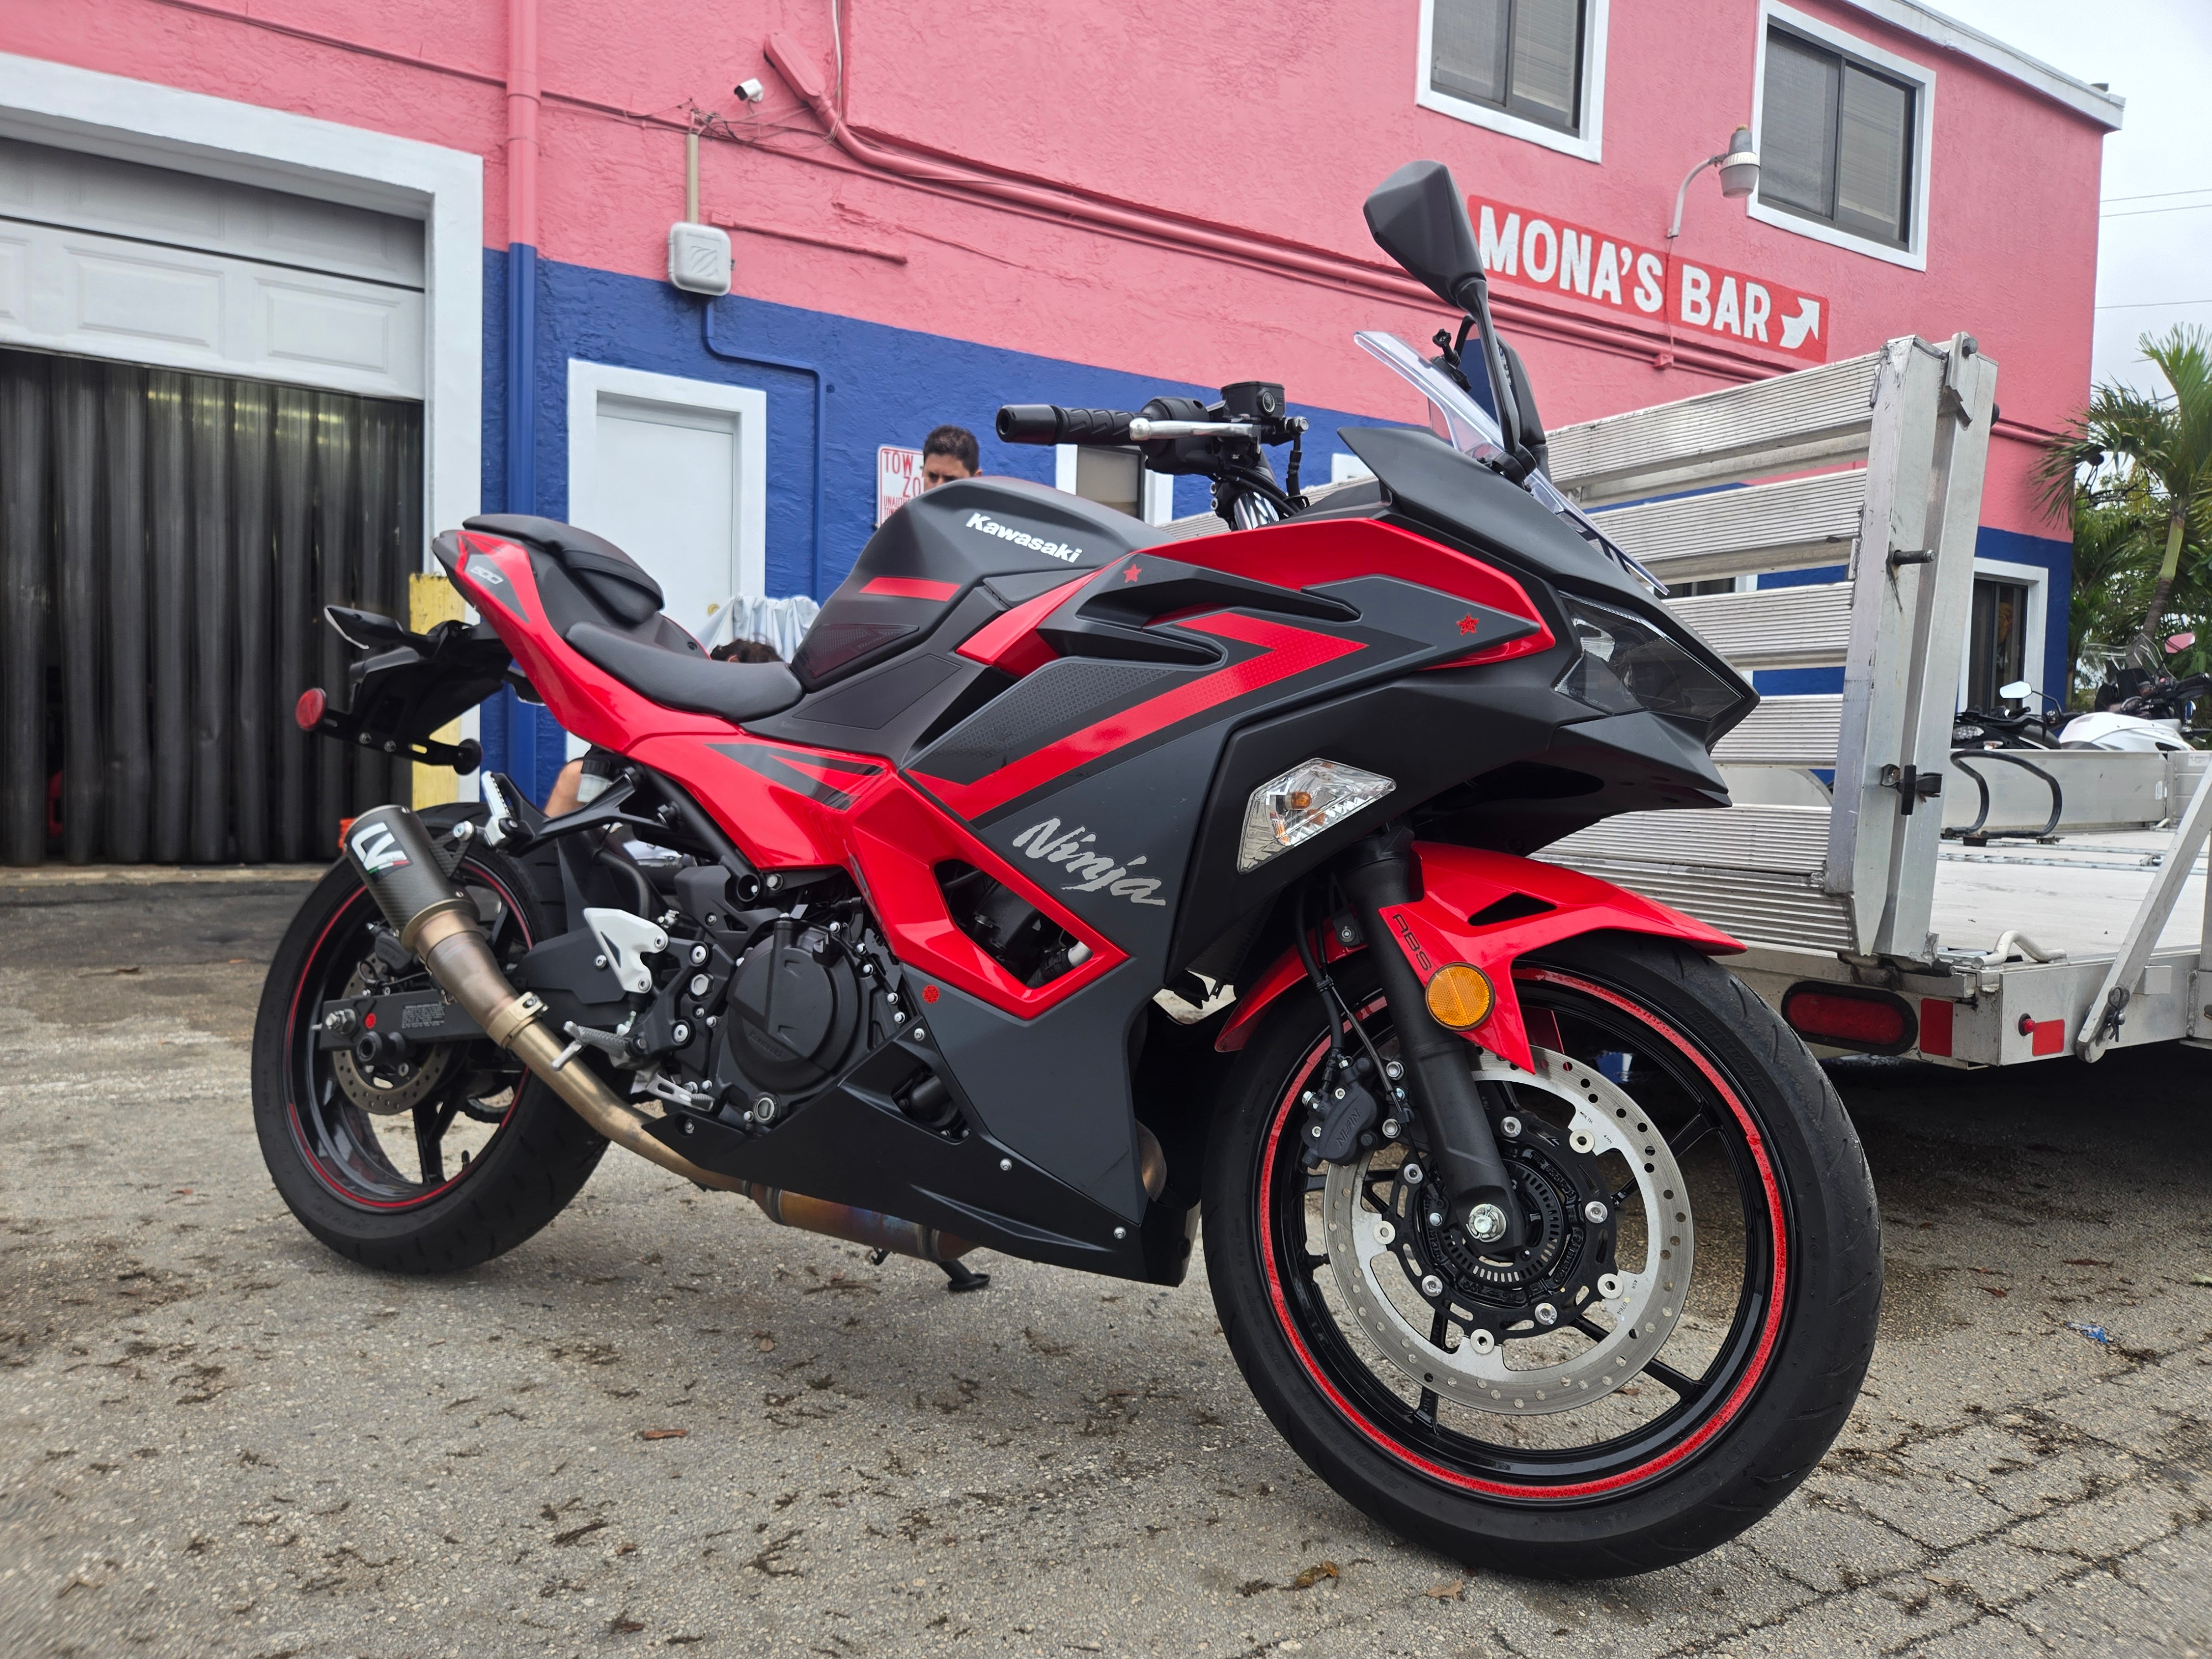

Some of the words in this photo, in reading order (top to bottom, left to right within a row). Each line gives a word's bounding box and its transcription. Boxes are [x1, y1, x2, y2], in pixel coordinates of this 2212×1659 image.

[1479, 205, 1663, 312] MONA'S
[1681, 264, 1771, 342] BAR
[884, 451, 914, 476] TOW
[902, 476, 921, 498] ZO
[966, 512, 1083, 564] Kawasaki
[470, 566, 504, 585] 500
[1012, 817, 1166, 906] Ninja
[1391, 914, 1432, 971] ABS
[1688, 1010, 1770, 1093] DUNLOP
